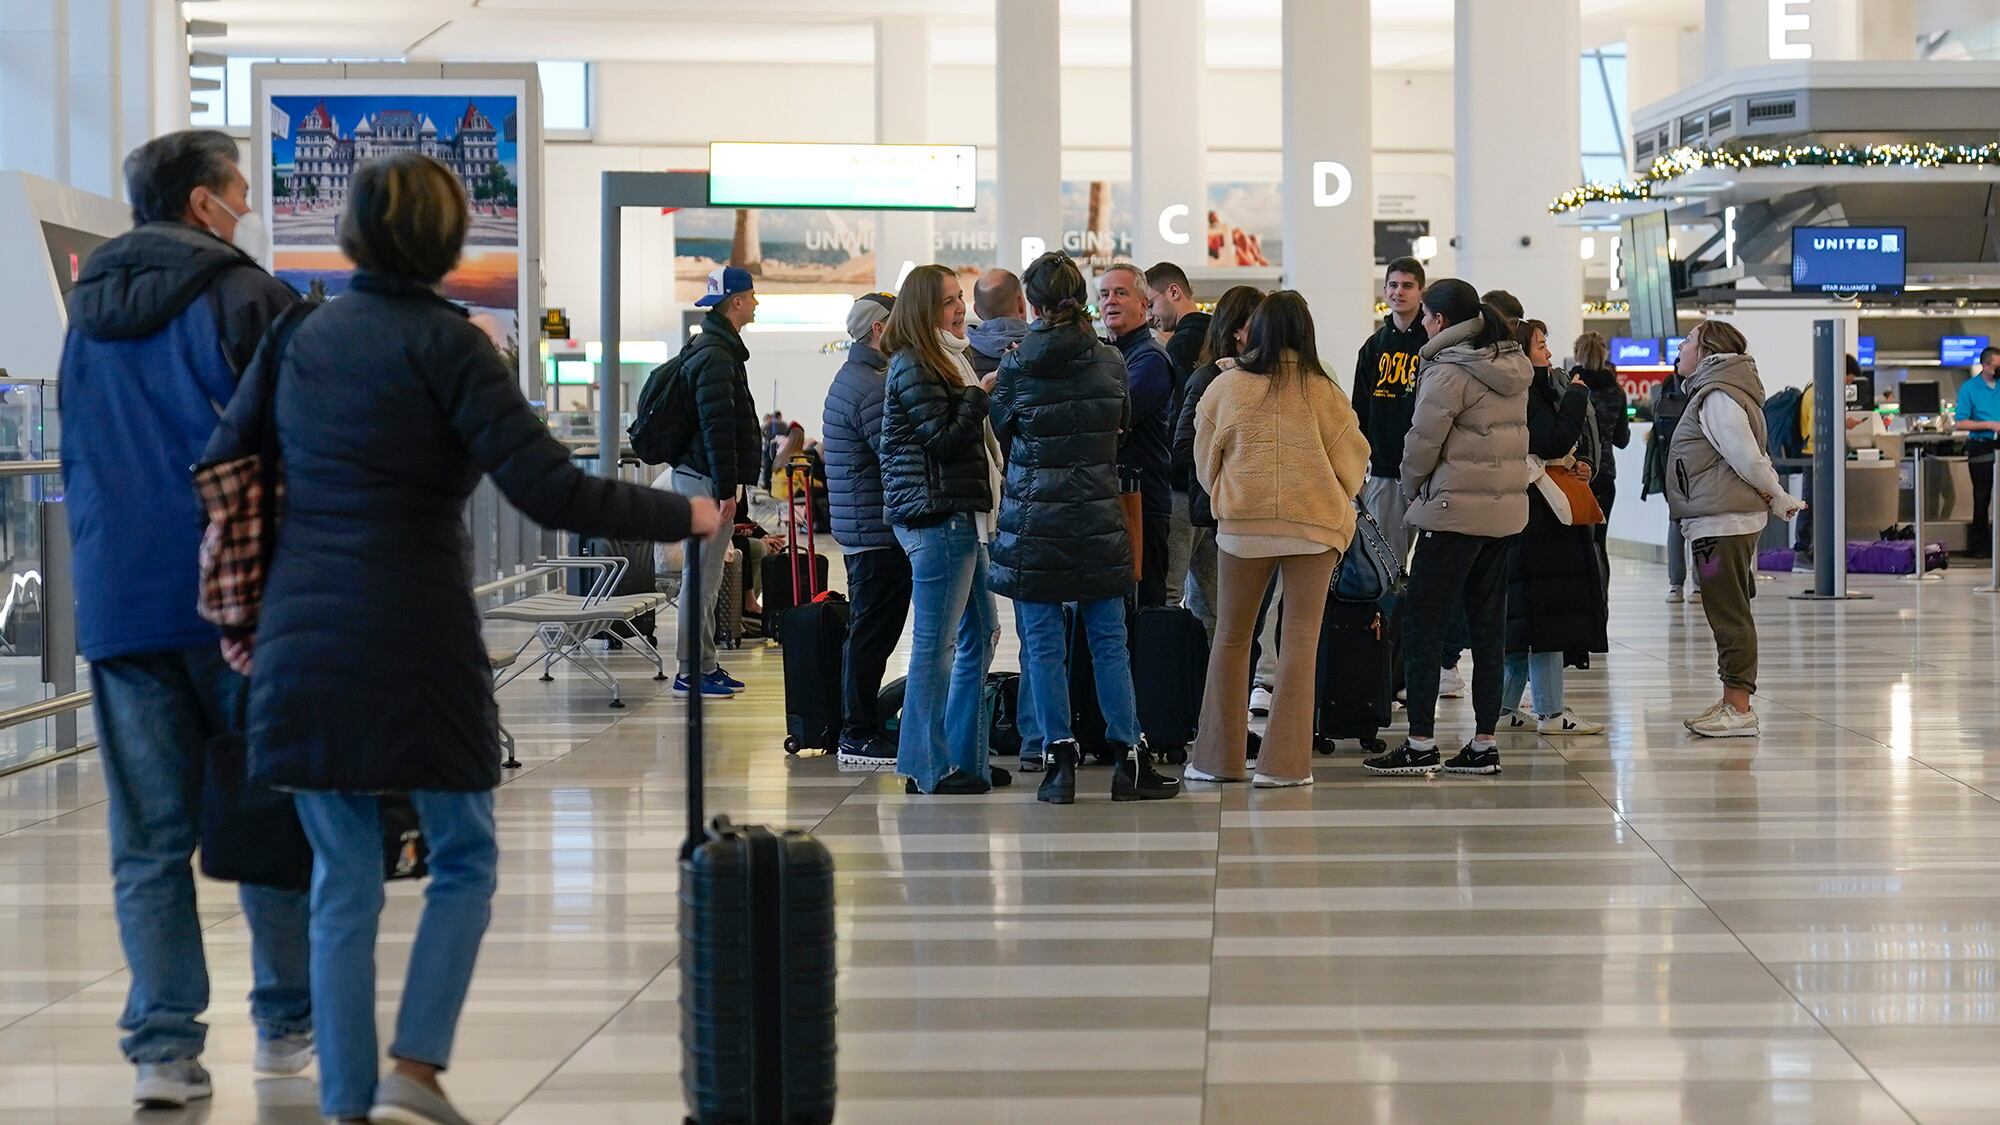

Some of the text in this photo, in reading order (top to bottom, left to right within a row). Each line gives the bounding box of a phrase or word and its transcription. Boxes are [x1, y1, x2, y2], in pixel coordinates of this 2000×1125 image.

[1768, 0, 1813, 60] E
[1312, 161, 1353, 208] D
[1062, 230, 1116, 251] GINS
[1158, 203, 1191, 246] C
[1813, 238, 1879, 251] UNITED
[1822, 284, 1870, 292] STAR ALLIANCE
